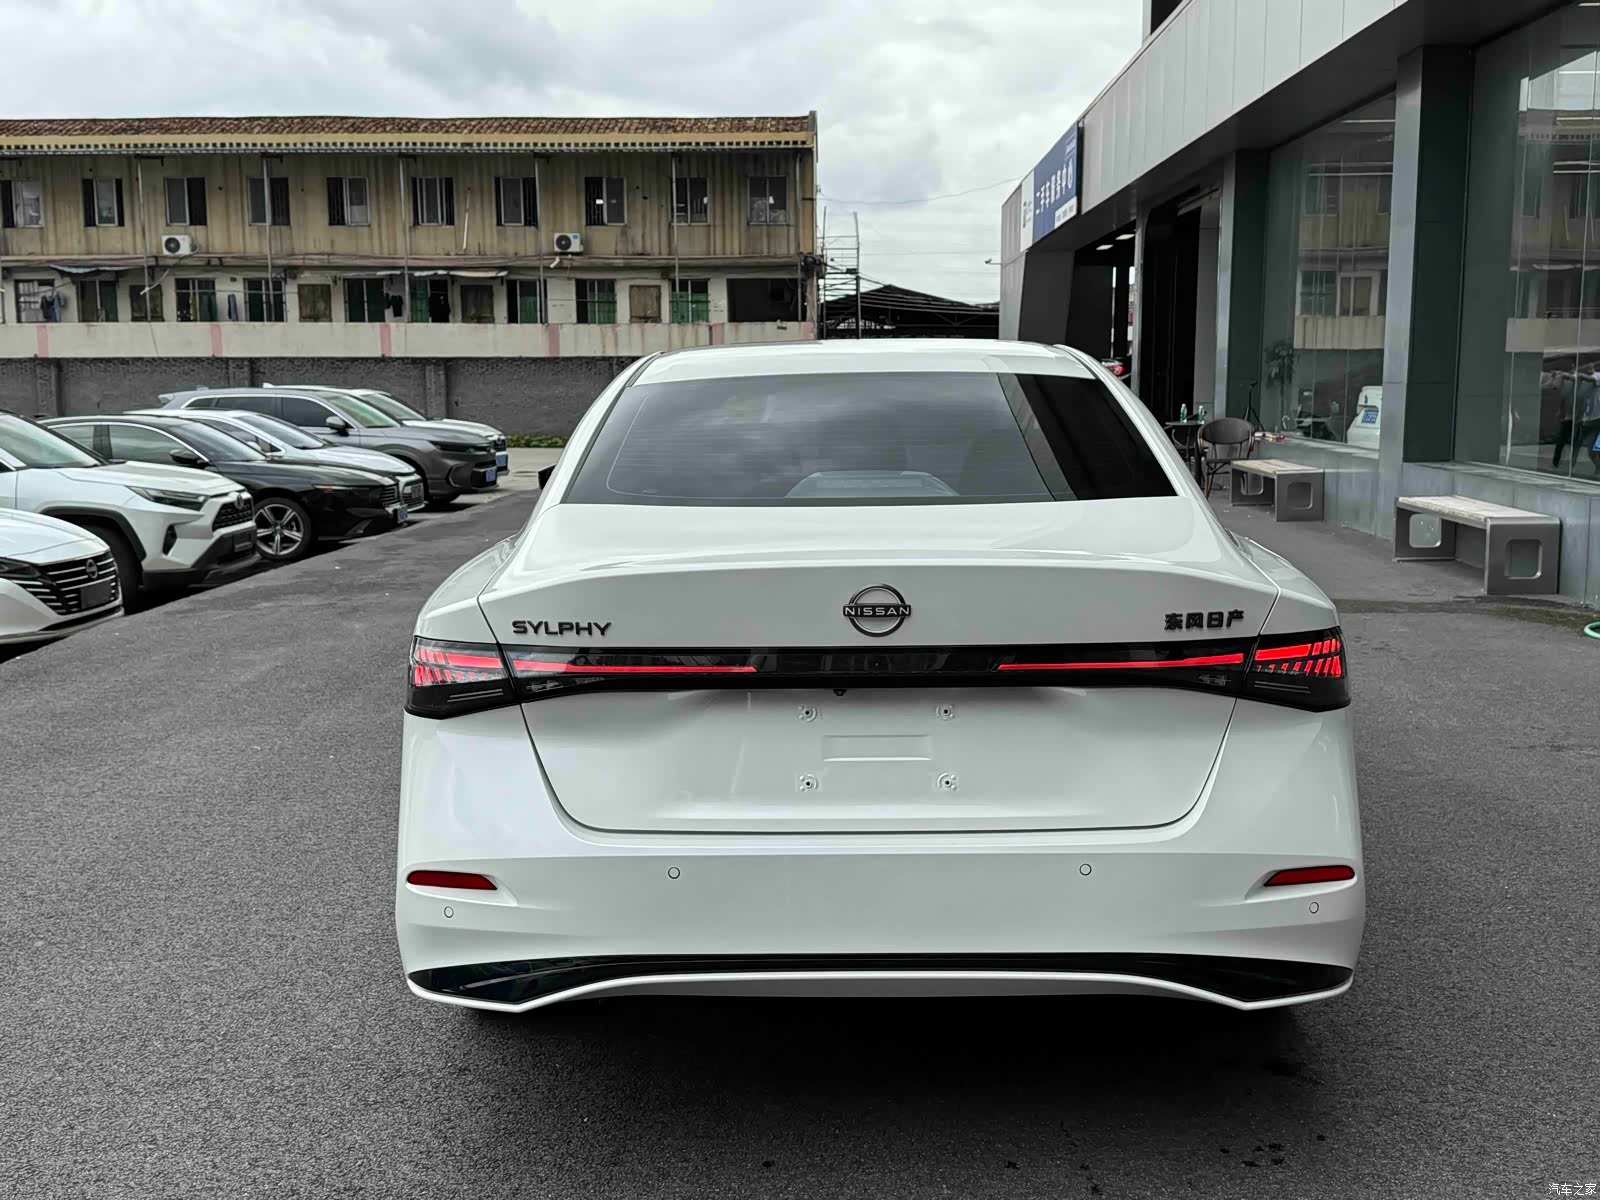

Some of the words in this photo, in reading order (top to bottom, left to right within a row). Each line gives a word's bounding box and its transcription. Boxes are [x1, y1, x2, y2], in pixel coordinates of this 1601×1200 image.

[844, 606, 910, 616] NISSAN
[1164, 609, 1244, 630] 东风日产
[511, 620, 612, 636] SYLPHY
